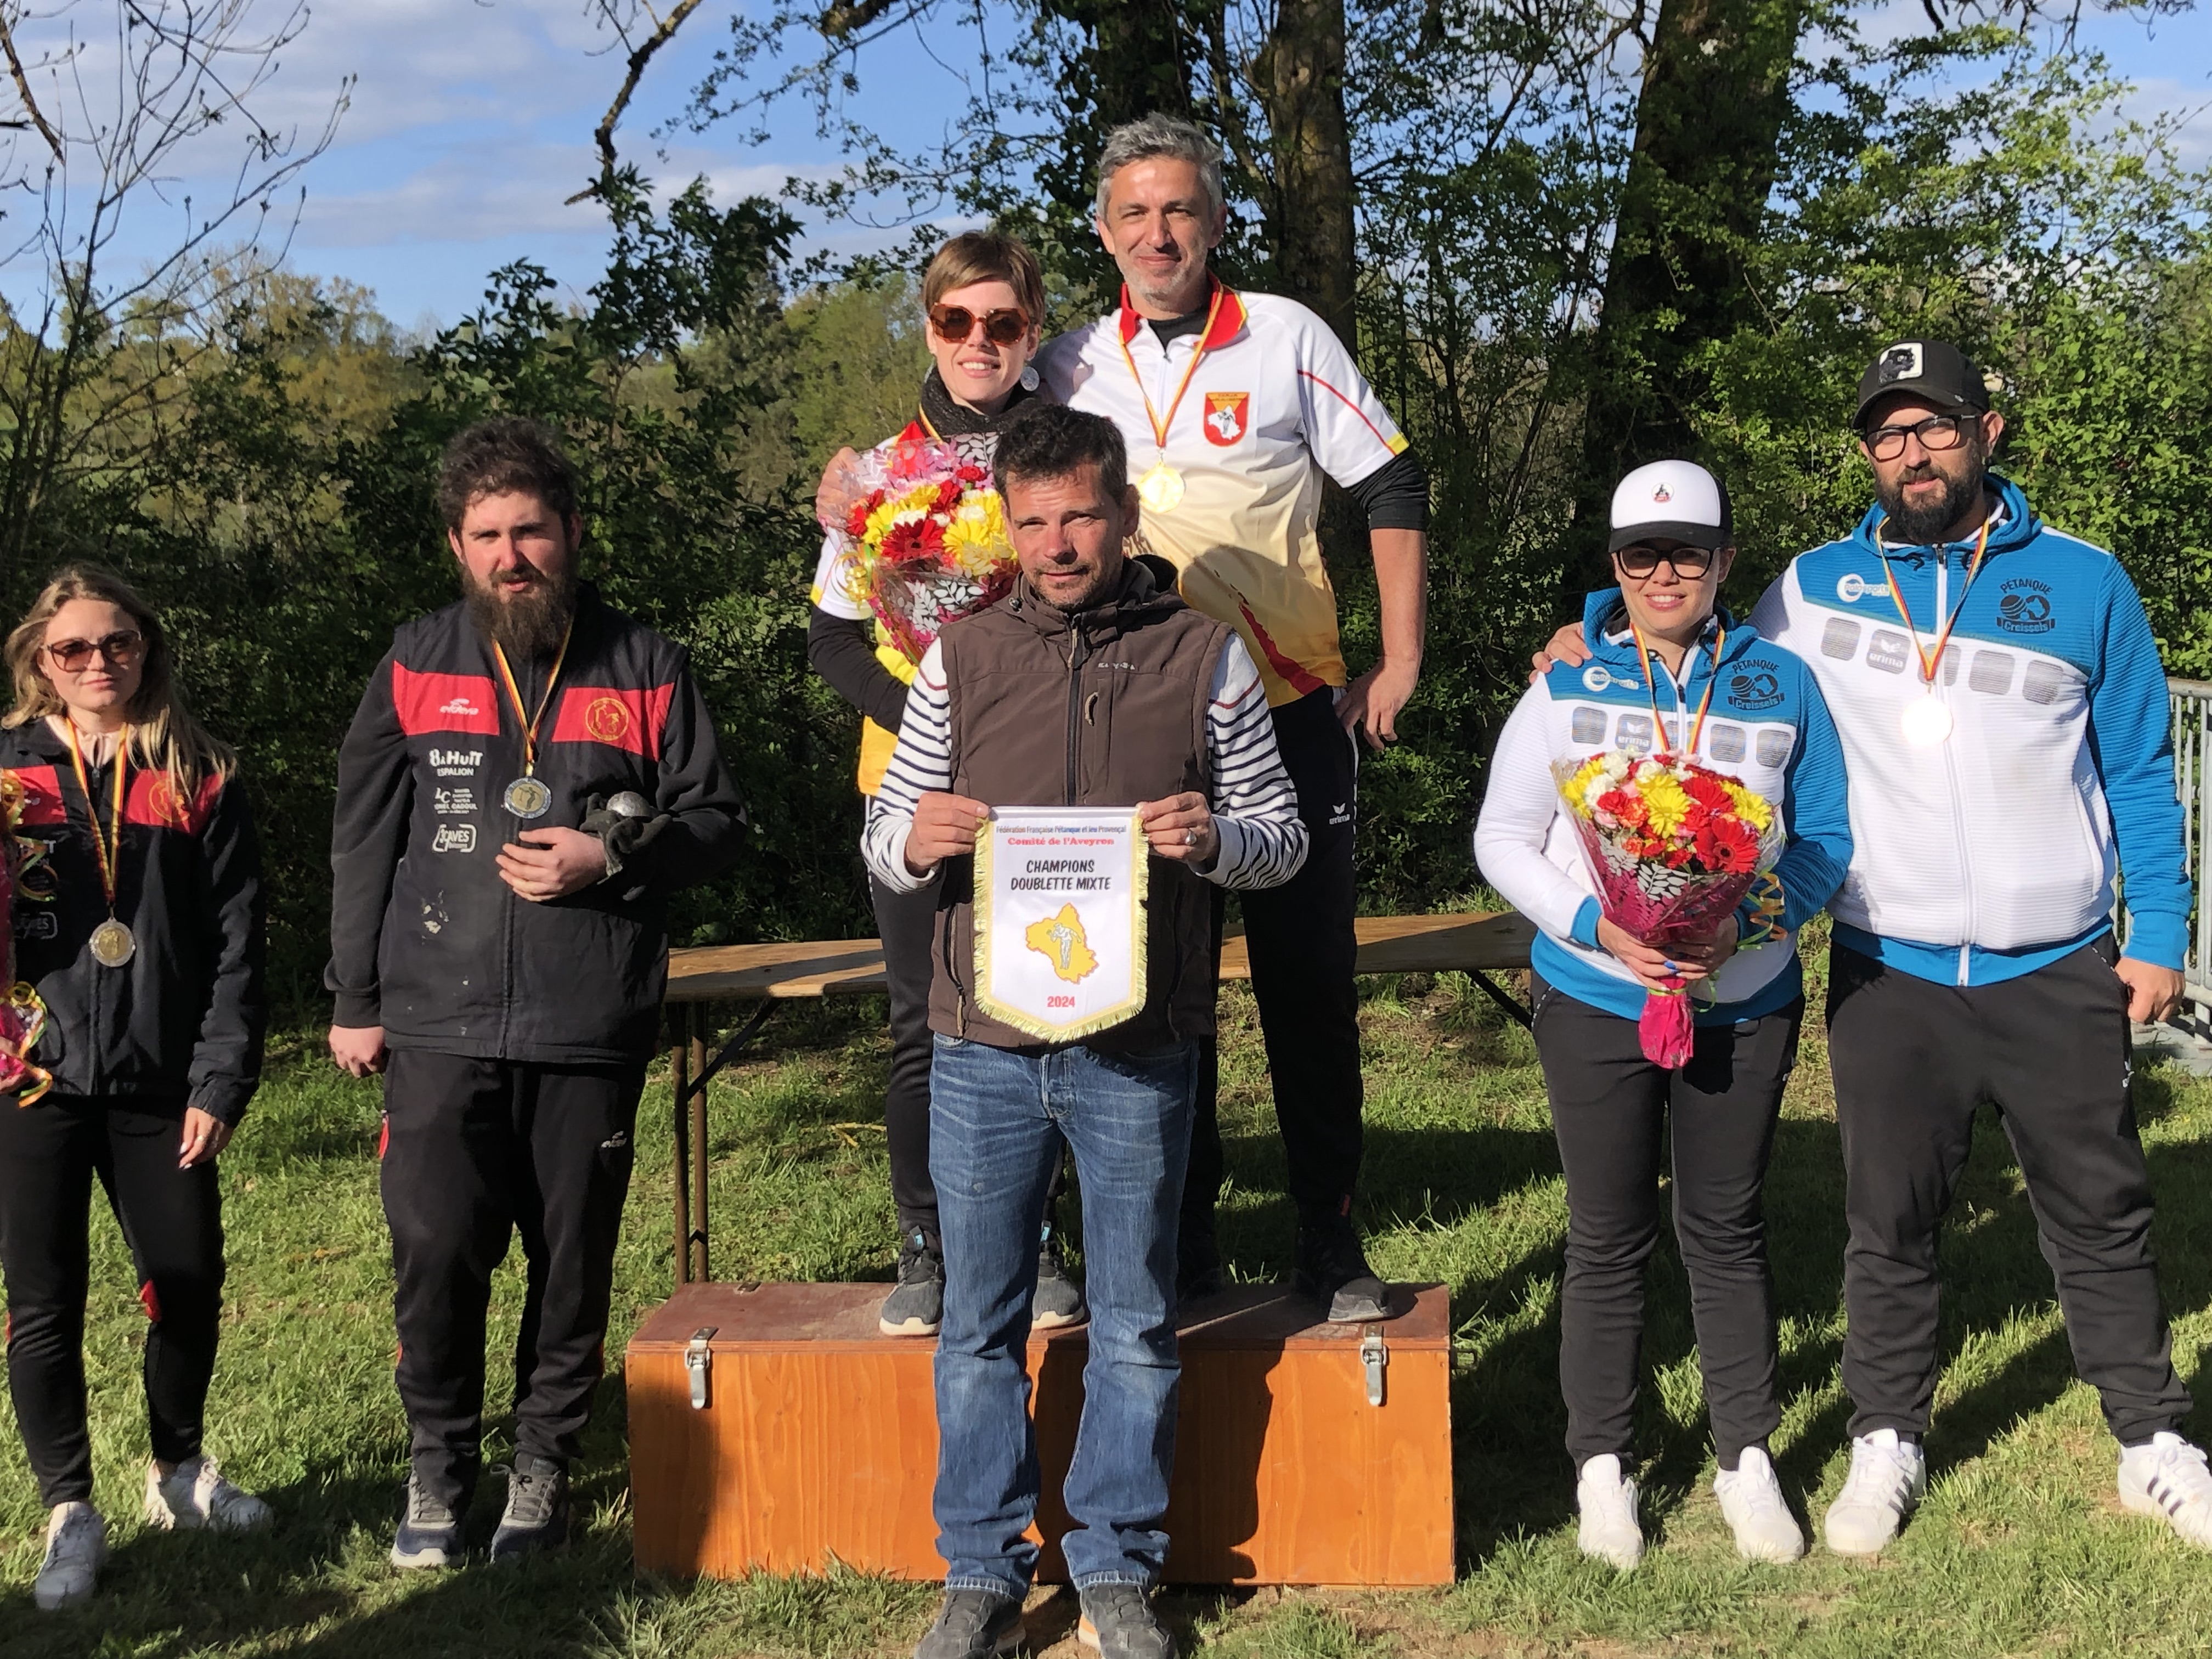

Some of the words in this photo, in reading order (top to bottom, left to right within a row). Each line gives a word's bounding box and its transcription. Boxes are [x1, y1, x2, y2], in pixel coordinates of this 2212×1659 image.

[1869, 652, 1904, 668] erima
[996, 825, 1026, 833] Fédération
[1027, 825, 1053, 834] Française
[1054, 825, 1081, 834] Pétanque
[1098, 825, 1127, 834] Provençal
[1008, 837, 1046, 845] Comité
[1048, 837, 1060, 845] de
[1063, 837, 1114, 847] l'Aveyron
[1026, 860, 1094, 873] CHAMPIONS
[1011, 877, 1074, 890] DOUBLETTE
[1076, 877, 1111, 890] MIXTE
[1047, 996, 1075, 1008] 2024
